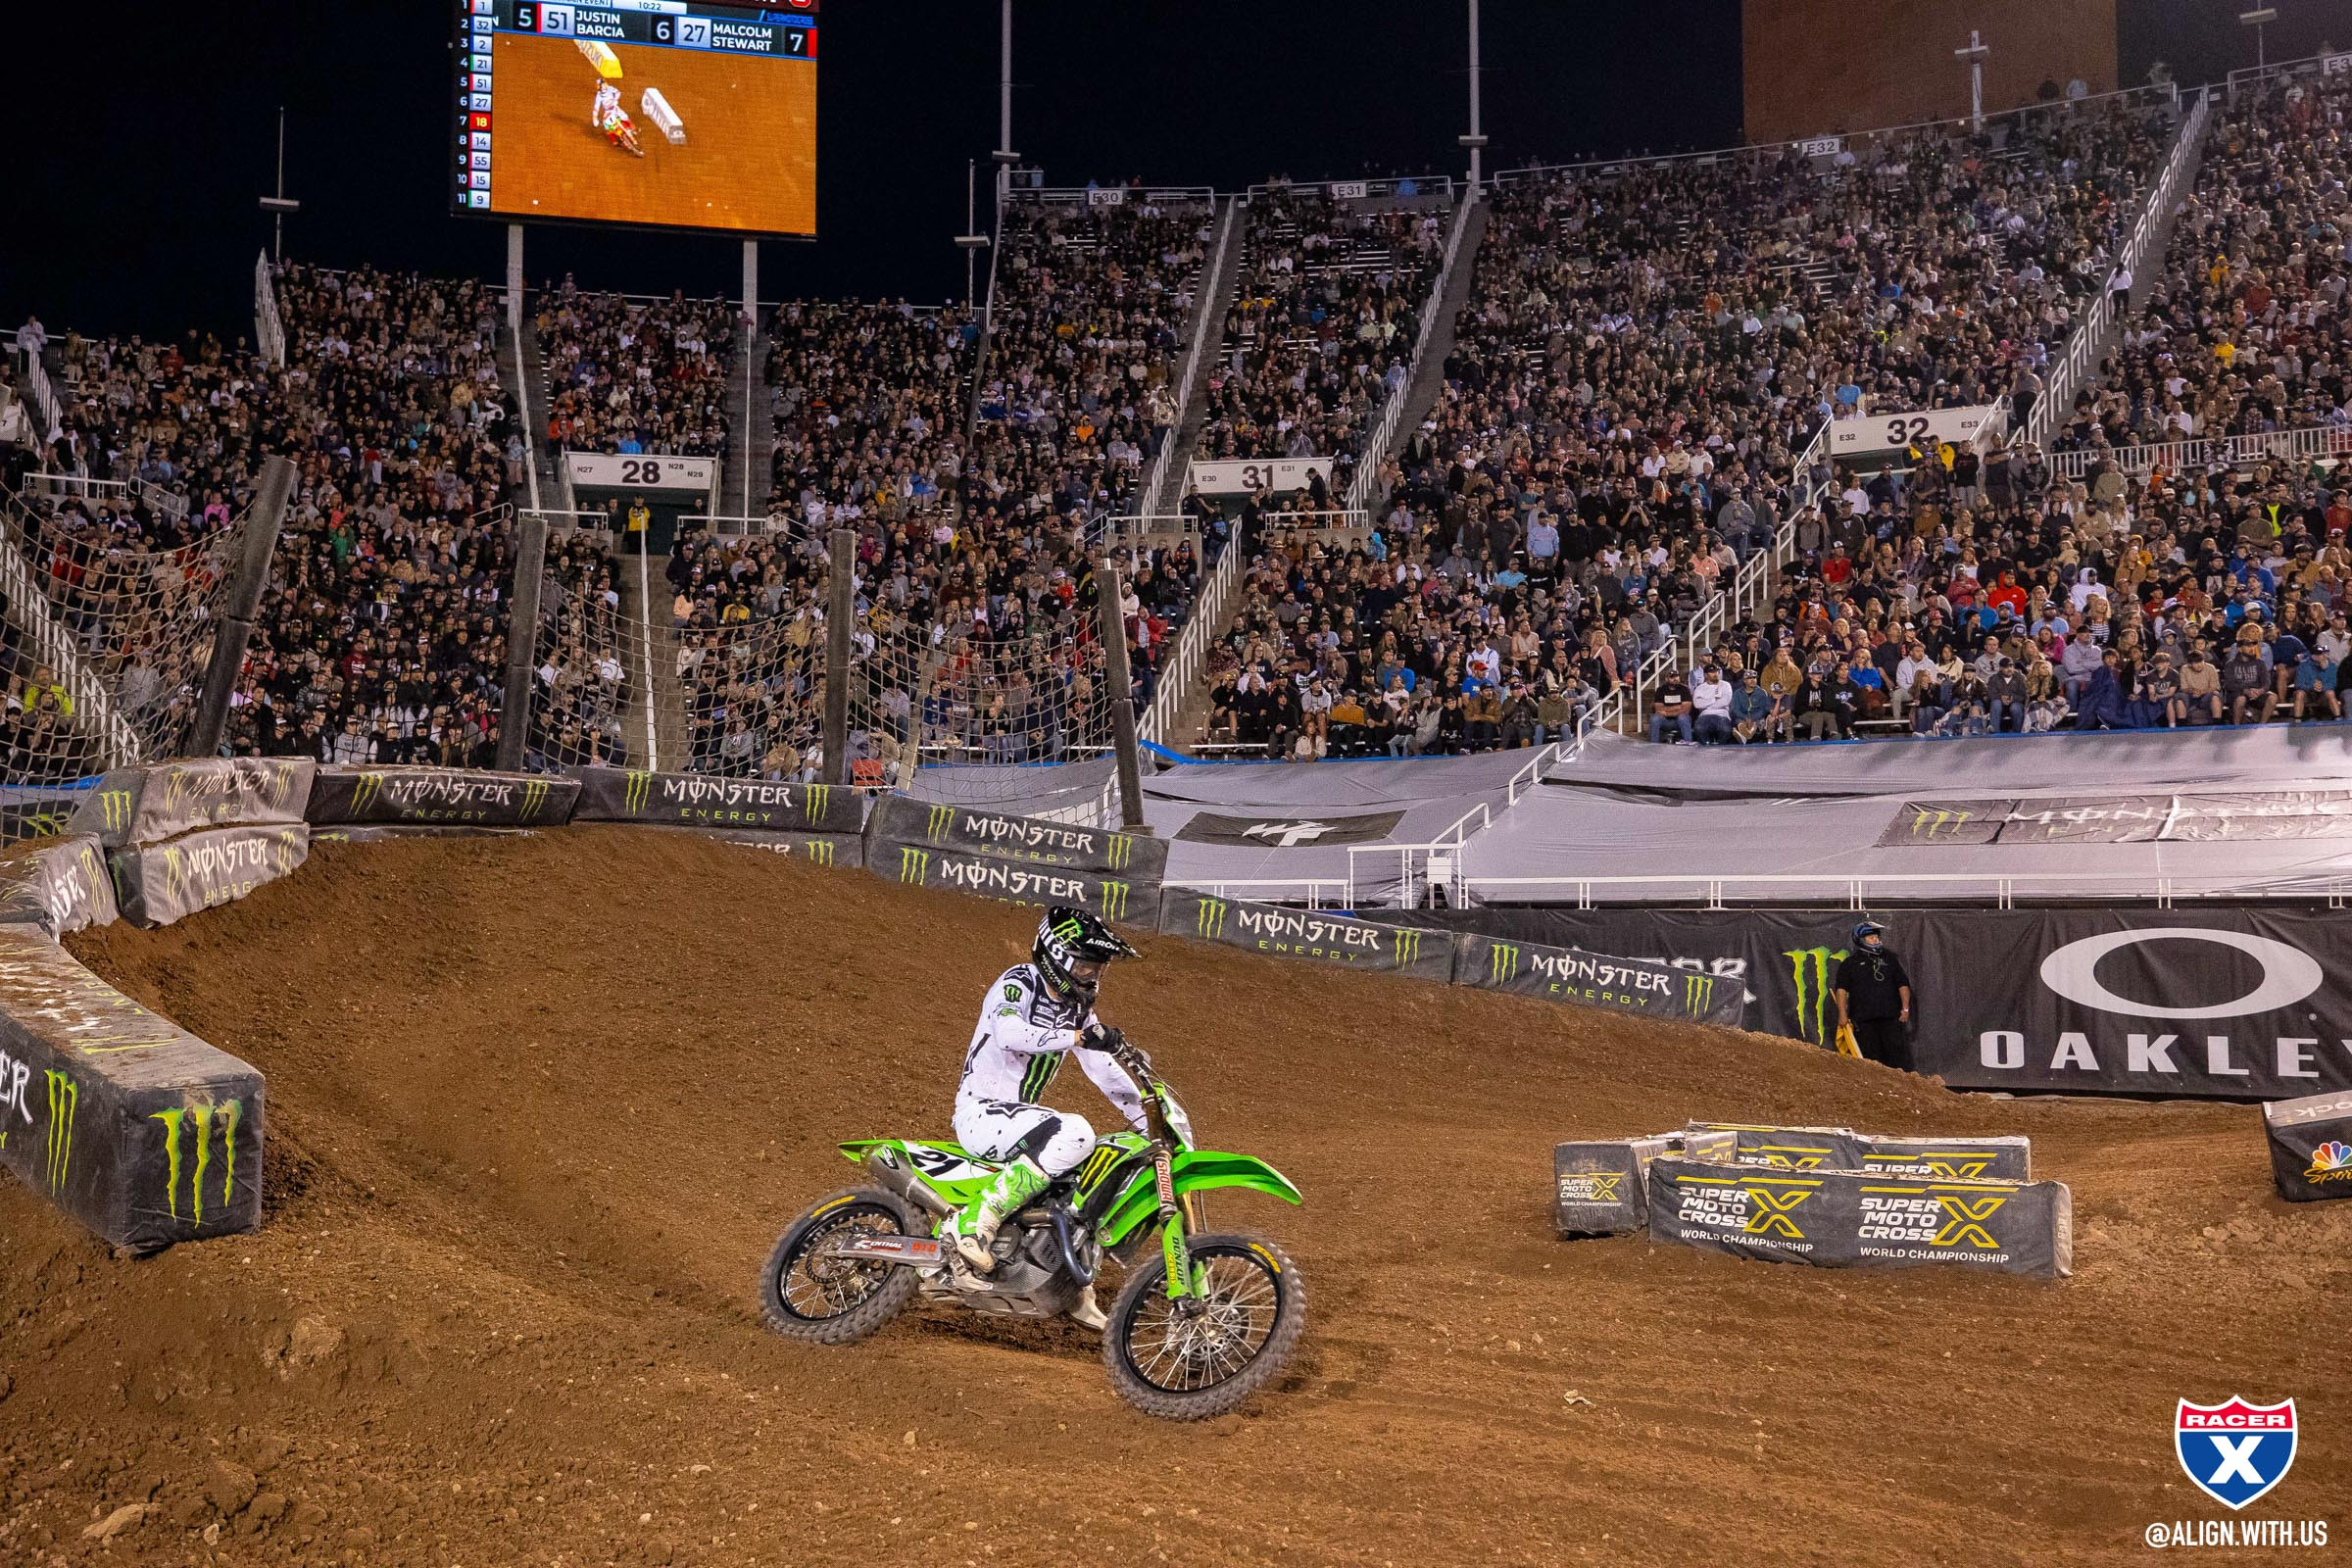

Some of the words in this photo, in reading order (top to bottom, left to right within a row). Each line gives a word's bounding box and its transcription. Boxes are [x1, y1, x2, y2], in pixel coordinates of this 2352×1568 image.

[461, 19, 468, 28] 2
[476, 21, 489, 30] 32
[518, 8, 532, 27] 5
[547, 12, 568, 30] 51
[576, 10, 620, 24] JUSTIN
[576, 24, 625, 38] BARCIA
[656, 22, 670, 40] 6
[683, 24, 706, 43] 27
[712, 24, 772, 39] MALCOLM
[461, 38, 468, 48] 3
[479, 40, 486, 50] 2
[712, 37, 772, 52] STEWART
[790, 34, 804, 52] 7
[460, 58, 468, 68] 4
[477, 60, 487, 69] 21
[460, 77, 467, 86] 5
[476, 78, 487, 88] 51
[460, 96, 467, 106] 6
[475, 98, 488, 108] 27
[460, 116, 467, 125] 7
[475, 117, 488, 127] 18
[459, 135, 467, 145] 8
[475, 137, 487, 147] 14
[1807, 141, 1836, 155] E32
[459, 155, 467, 165] 9
[474, 157, 487, 166] 55
[457, 173, 467, 184] 10
[475, 175, 486, 185] 15
[1093, 192, 1119, 203] E30
[1338, 185, 1360, 196] E31
[458, 193, 466, 203] 11
[476, 195, 484, 205] 9
[1838, 433, 1856, 442] E32
[1886, 416, 1930, 445] 32
[1960, 420, 1979, 429] E33
[621, 460, 662, 484] 28
[1242, 465, 1274, 489] 31
[391, 776, 513, 806] MONSTER
[663, 777, 792, 808] MONSTER
[400, 808, 486, 820] ENERGY
[681, 808, 771, 822] ENERGY
[965, 815, 1094, 855] MONSTER
[187, 836, 270, 882] MONSTER
[981, 844, 1074, 863] ENERGY
[942, 859, 1087, 903] MONSTER
[1238, 909, 1381, 951] MONSTER
[1258, 940, 1357, 961] ENERGY
[1532, 953, 1672, 996] MONSTER
[1549, 983, 1648, 1006] ENERGY
[1559, 1178, 1593, 1187] SUPER
[1677, 1187, 1750, 1203] SUPER
[1682, 1198, 1746, 1215] MOTO
[1858, 1198, 1942, 1213] SUPER
[1678, 1209, 1749, 1228] CROSS
[1863, 1211, 1937, 1227] MOTO
[1681, 1229, 1720, 1241] WORLD
[1722, 1234, 1813, 1253] CHAMPIONSHIP
[1858, 1225, 1937, 1242] CROSS
[1860, 1247, 1906, 1258] WORLD
[1908, 1250, 2009, 1264] CHAMPIONSHIP
